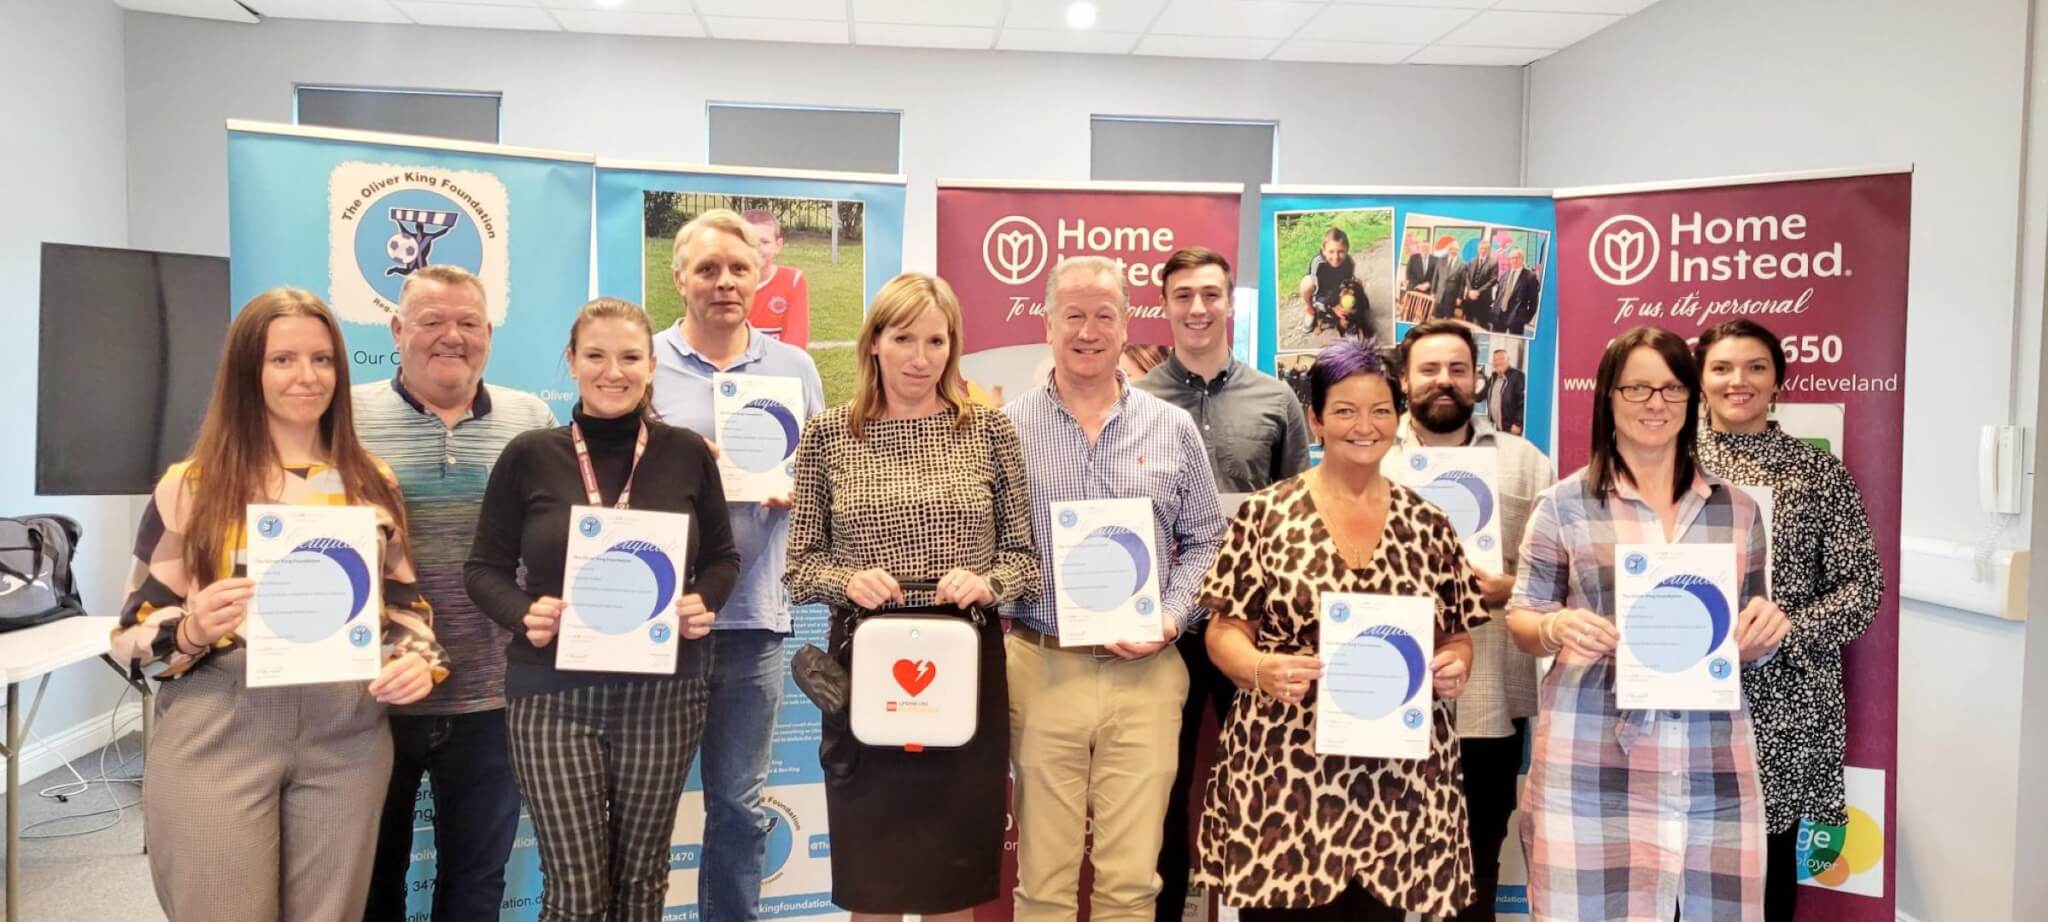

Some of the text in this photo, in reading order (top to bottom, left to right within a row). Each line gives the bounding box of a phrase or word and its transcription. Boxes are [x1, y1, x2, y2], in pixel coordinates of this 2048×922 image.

[342, 172, 496, 239] The Oliver King Foundation
[1057, 218, 1175, 252] Home
[1671, 211, 1807, 246] Home
[1005, 296, 1028, 322] To
[1614, 297, 1639, 324] To
[1638, 302, 1664, 319] us,
[1697, 287, 1815, 326] personal
[353, 350, 385, 366] Our
[1781, 336, 1844, 364] 650
[540, 390, 573, 402] Oliver
